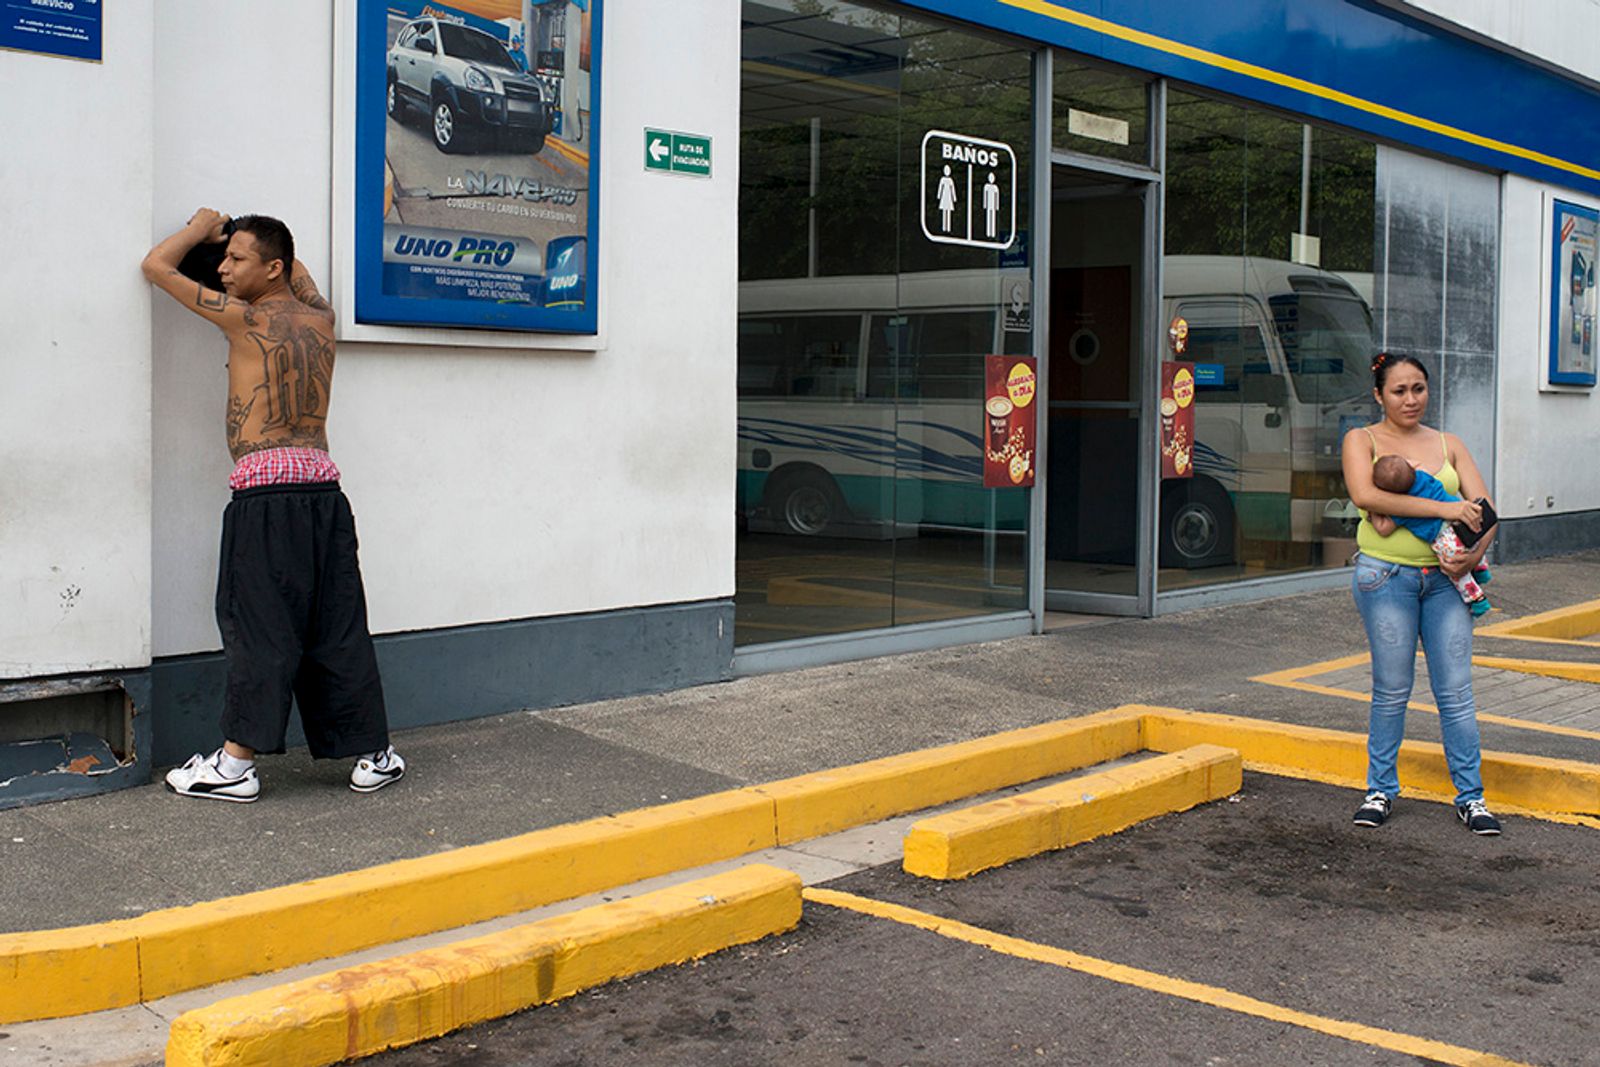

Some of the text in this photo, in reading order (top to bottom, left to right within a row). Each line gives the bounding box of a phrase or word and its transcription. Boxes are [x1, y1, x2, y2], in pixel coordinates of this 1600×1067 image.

[679, 143, 704, 154] RUTA DE
[942, 143, 999, 168] BAÑOS
[447, 176, 464, 189] LA
[464, 170, 541, 202] NAVE
[394, 235, 516, 267] UNO PRO
[550, 273, 579, 291] UNO
